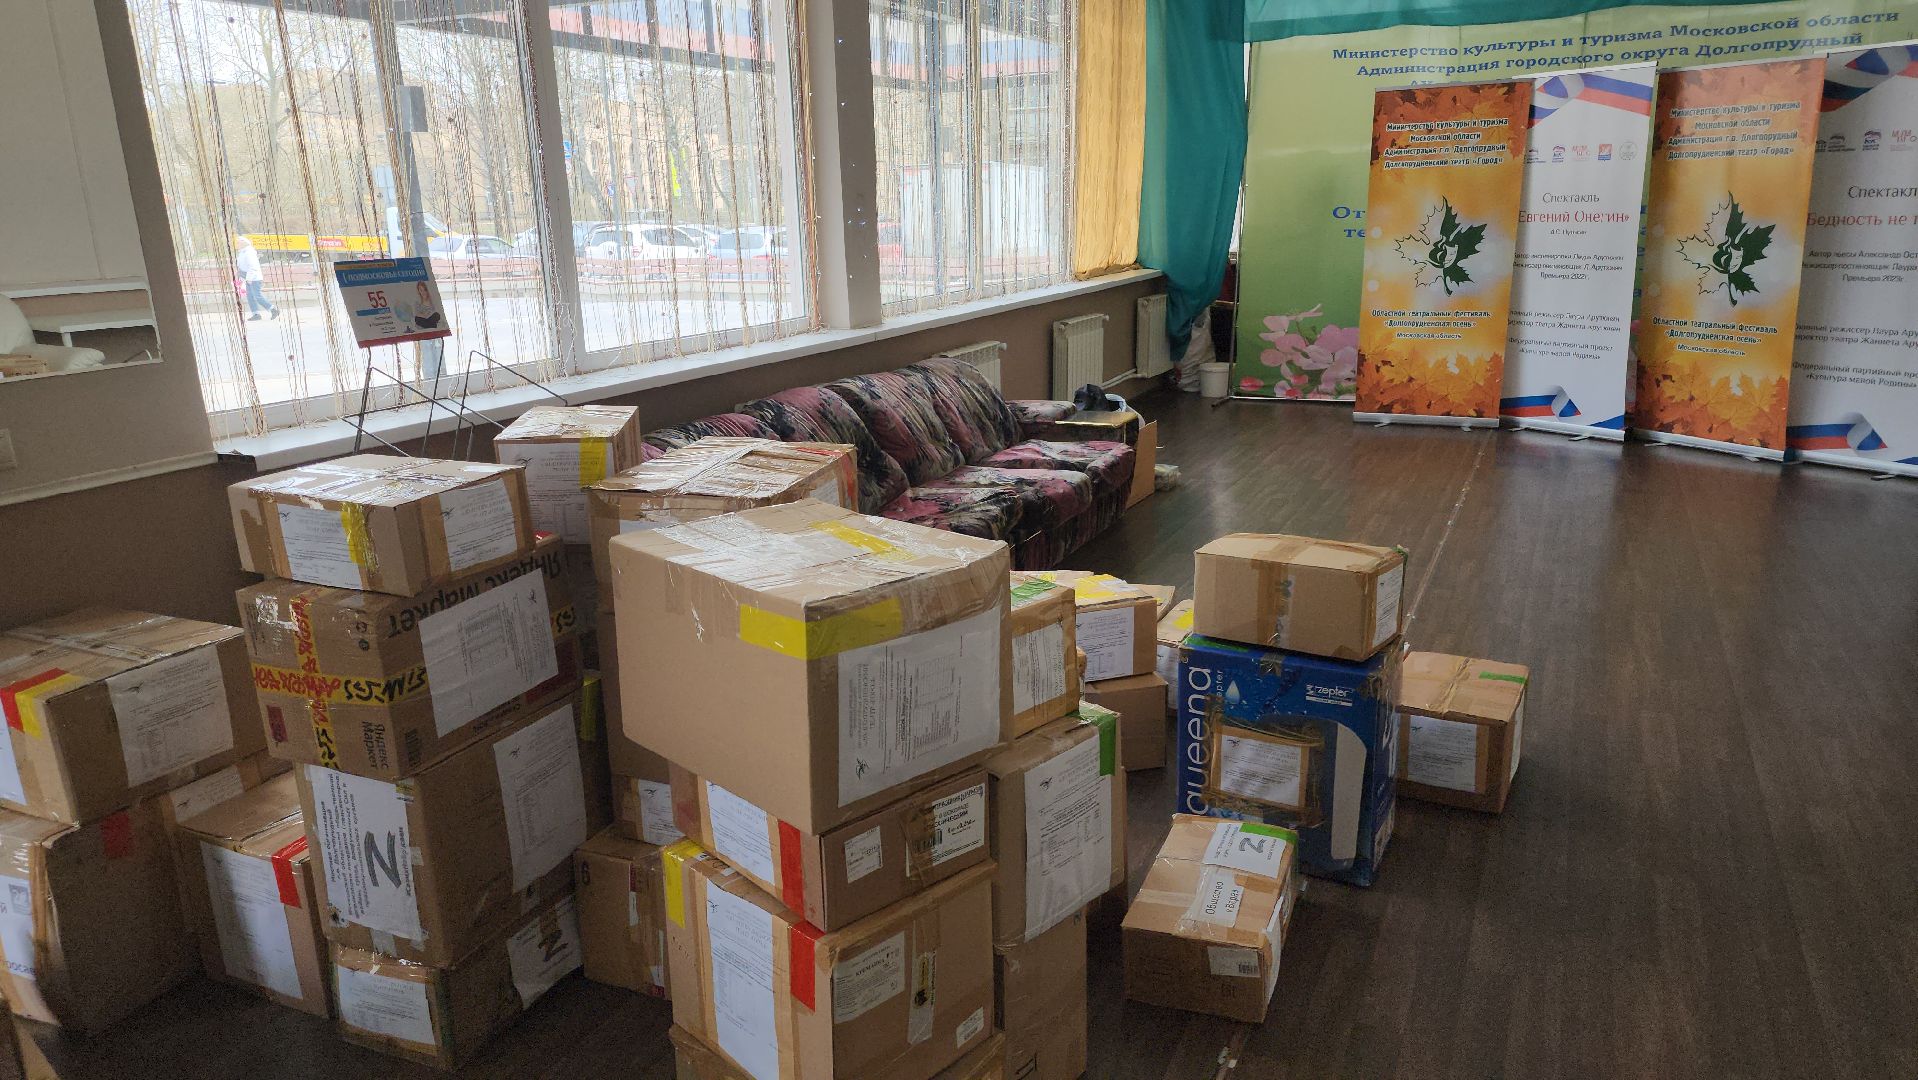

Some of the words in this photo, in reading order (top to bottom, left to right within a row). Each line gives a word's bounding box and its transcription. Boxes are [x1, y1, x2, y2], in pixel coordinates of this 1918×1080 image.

[1333, 46, 1458, 60] Министерство
[1463, 37, 1556, 56] культуры
[1561, 37, 1573, 47] и
[1579, 29, 1663, 51] туризма
[1670, 17, 1800, 38] Московской
[1807, 11, 1899, 28] области
[1356, 60, 1500, 77] Администрация
[1505, 52, 1615, 71] городского
[1622, 46, 1690, 63] округа
[1695, 31, 1863, 58] Долгопрудный
[1671, 106, 1720, 117] Министерство
[1722, 104, 1759, 115] культуры
[1769, 101, 1801, 111] туризма
[1386, 122, 1434, 132] Министерство
[1436, 120, 1471, 130] культуры
[1479, 118, 1508, 128] туризма
[1695, 120, 1738, 130] Московской
[1741, 118, 1771, 127] области
[1410, 133, 1451, 142] Московской
[1453, 132, 1482, 141] области
[1668, 135, 1723, 146] Администрация
[1741, 130, 1798, 142] Долгопрудный
[1384, 146, 1437, 156] Администрация
[1453, 144, 1507, 154] Долгопрудный
[1542, 192, 1600, 203] Спектакль
[1848, 185, 1918, 199] Спектакл
[1518, 210, 1570, 223] Евгений
[1806, 212, 1883, 228] Бедность
[1888, 215, 1908, 226] не
[367, 290, 388, 309] 55
[1371, 308, 1406, 317] Областной
[1652, 316, 1688, 327] Областной
[1691, 319, 1736, 330] театральный
[1738, 323, 1778, 334] фестиваль
[1317, 685, 1350, 698] zepter
[362, 720, 379, 769] Маркет
[374, 723, 390, 770] Яндекс
[1186, 666, 1212, 816] queena
